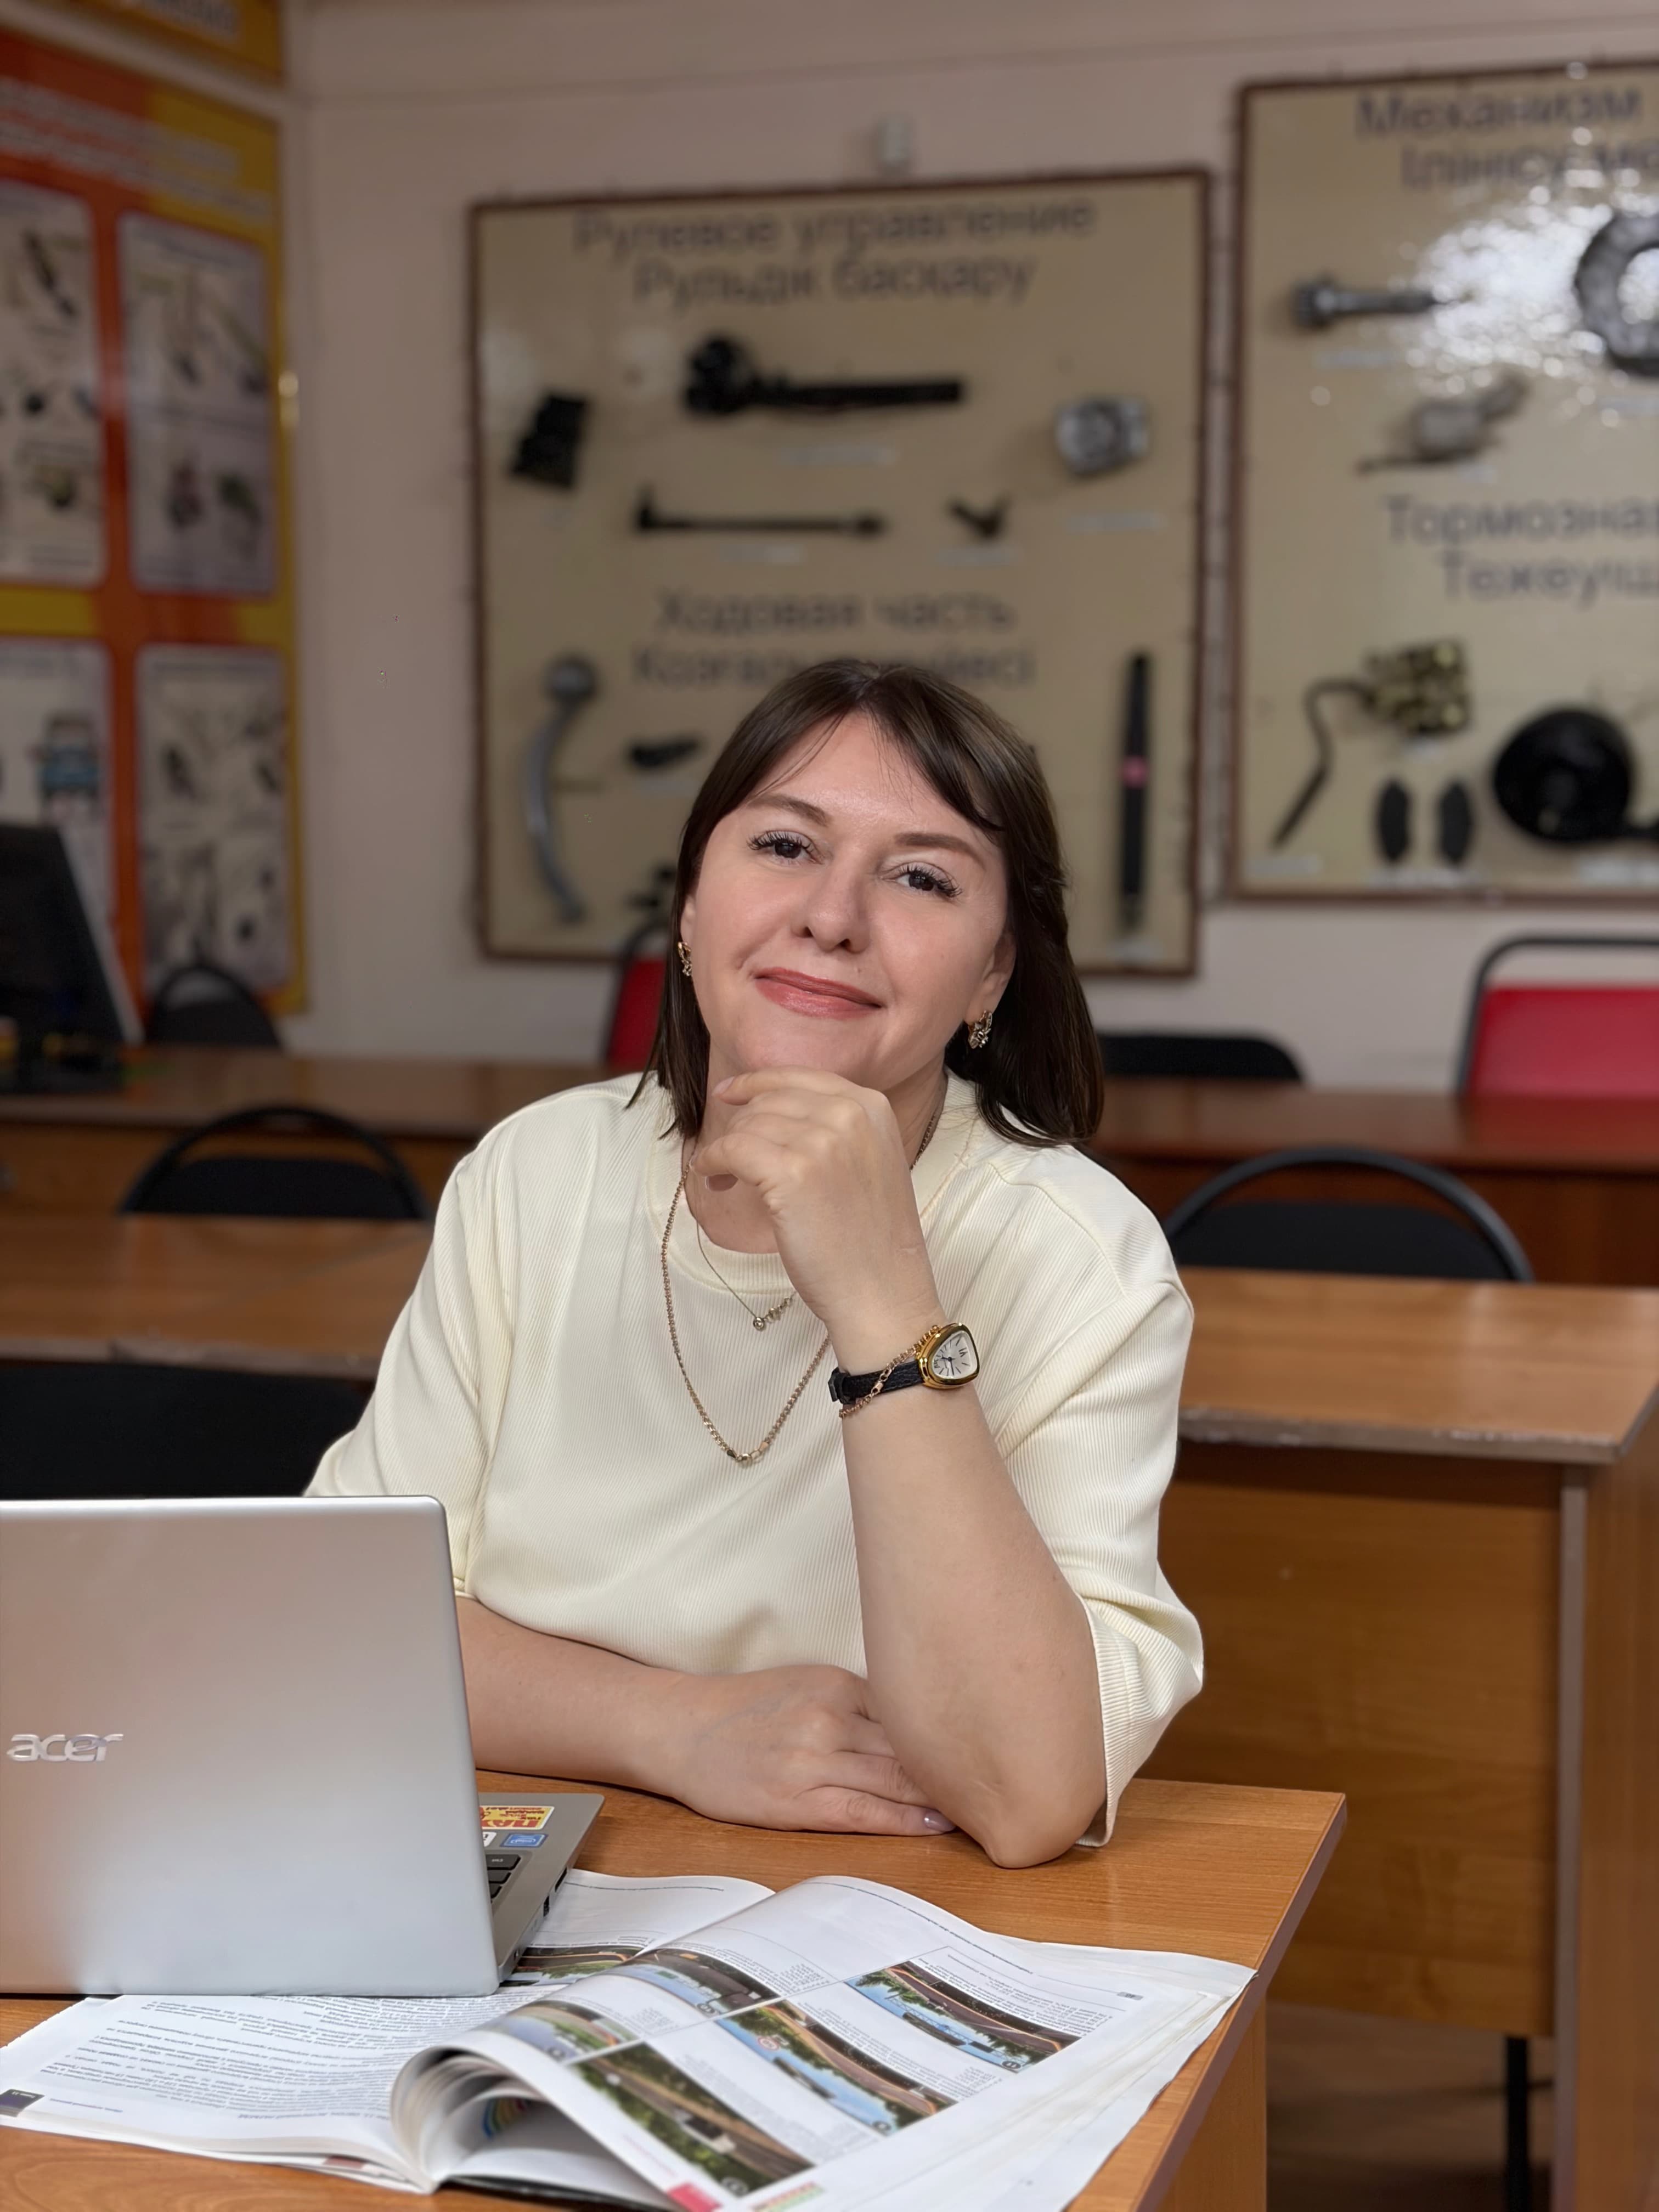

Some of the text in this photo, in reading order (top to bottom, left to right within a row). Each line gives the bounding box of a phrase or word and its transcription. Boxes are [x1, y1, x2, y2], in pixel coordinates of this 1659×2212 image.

[1356, 87, 1641, 139] Механизм
[573, 199, 1096, 264] Рулевое управление
[1379, 495, 1659, 551] Тормозна
[655, 587, 1017, 636] Ходовая часть
[7, 1734, 124, 1762] acer
